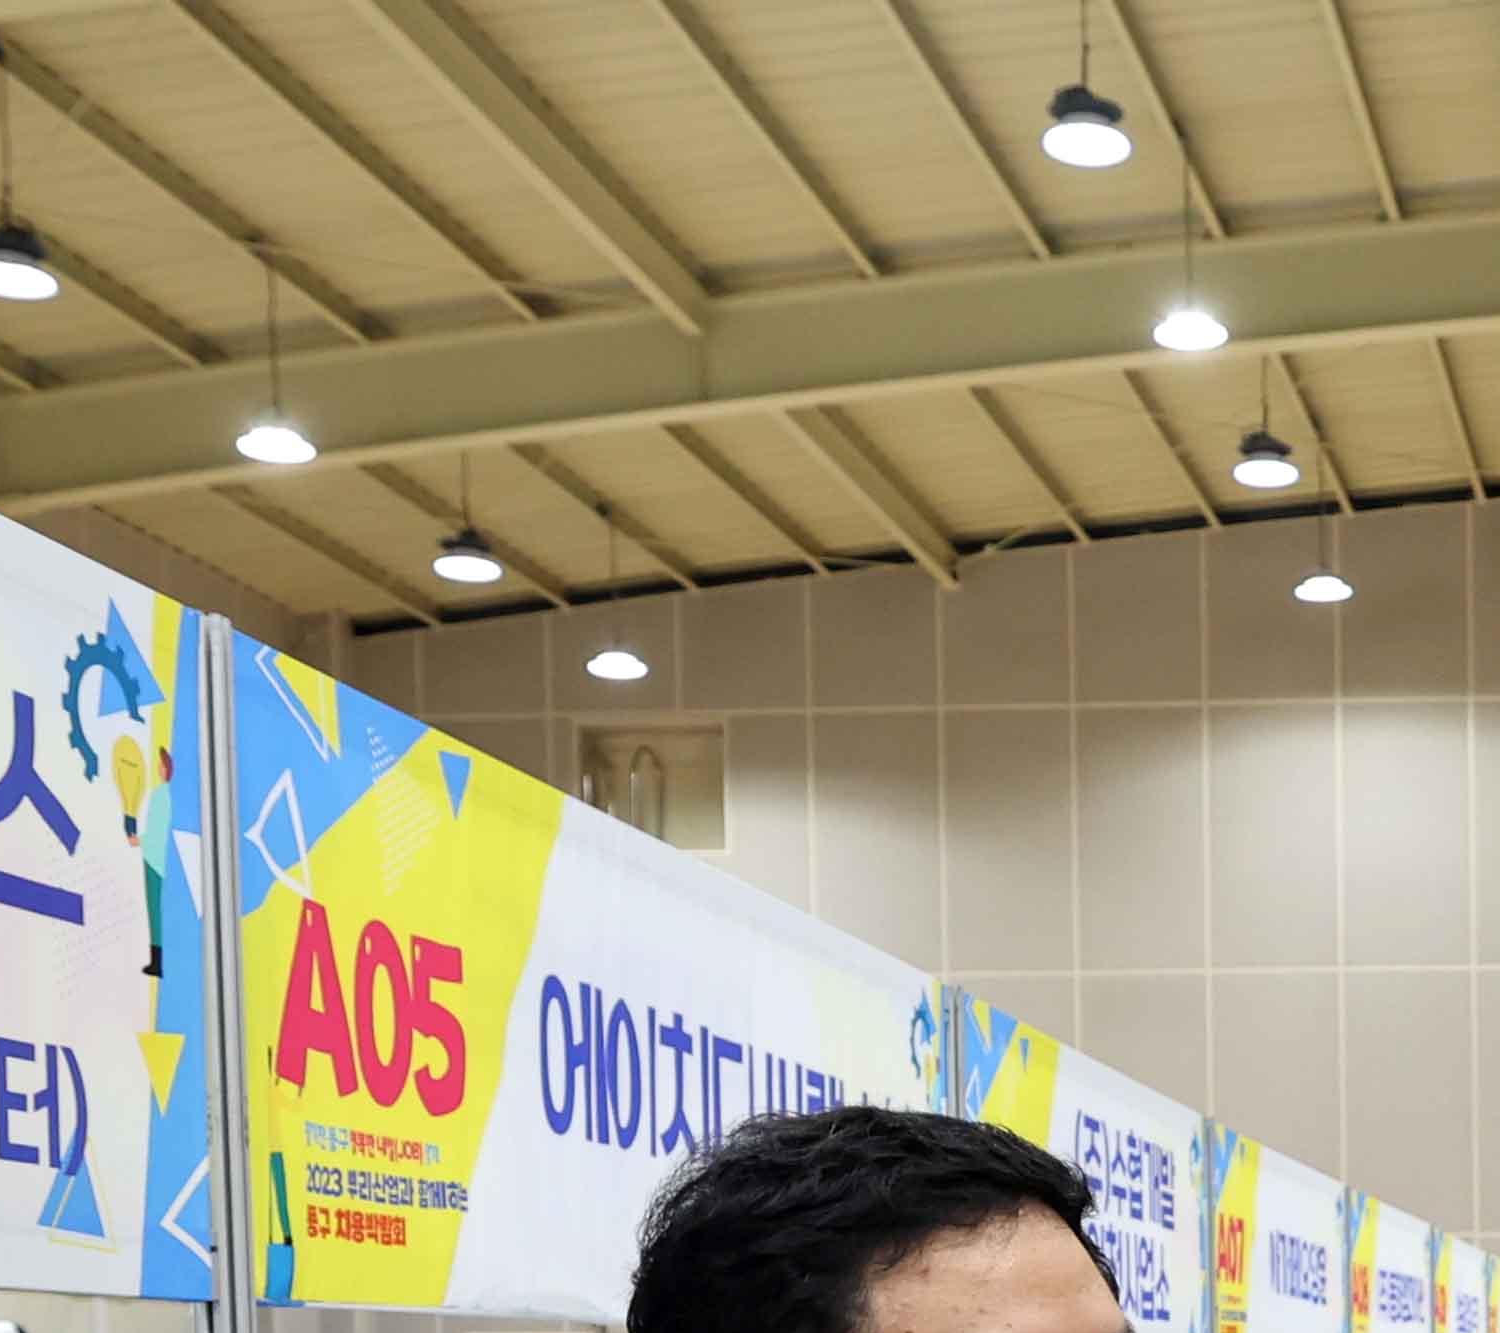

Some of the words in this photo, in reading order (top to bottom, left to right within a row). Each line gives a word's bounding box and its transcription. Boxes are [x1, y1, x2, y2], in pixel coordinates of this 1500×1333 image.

[275, 898, 467, 1118] A05
[306, 1163, 343, 1198] 2023
[307, 1204, 331, 1240] 동구
